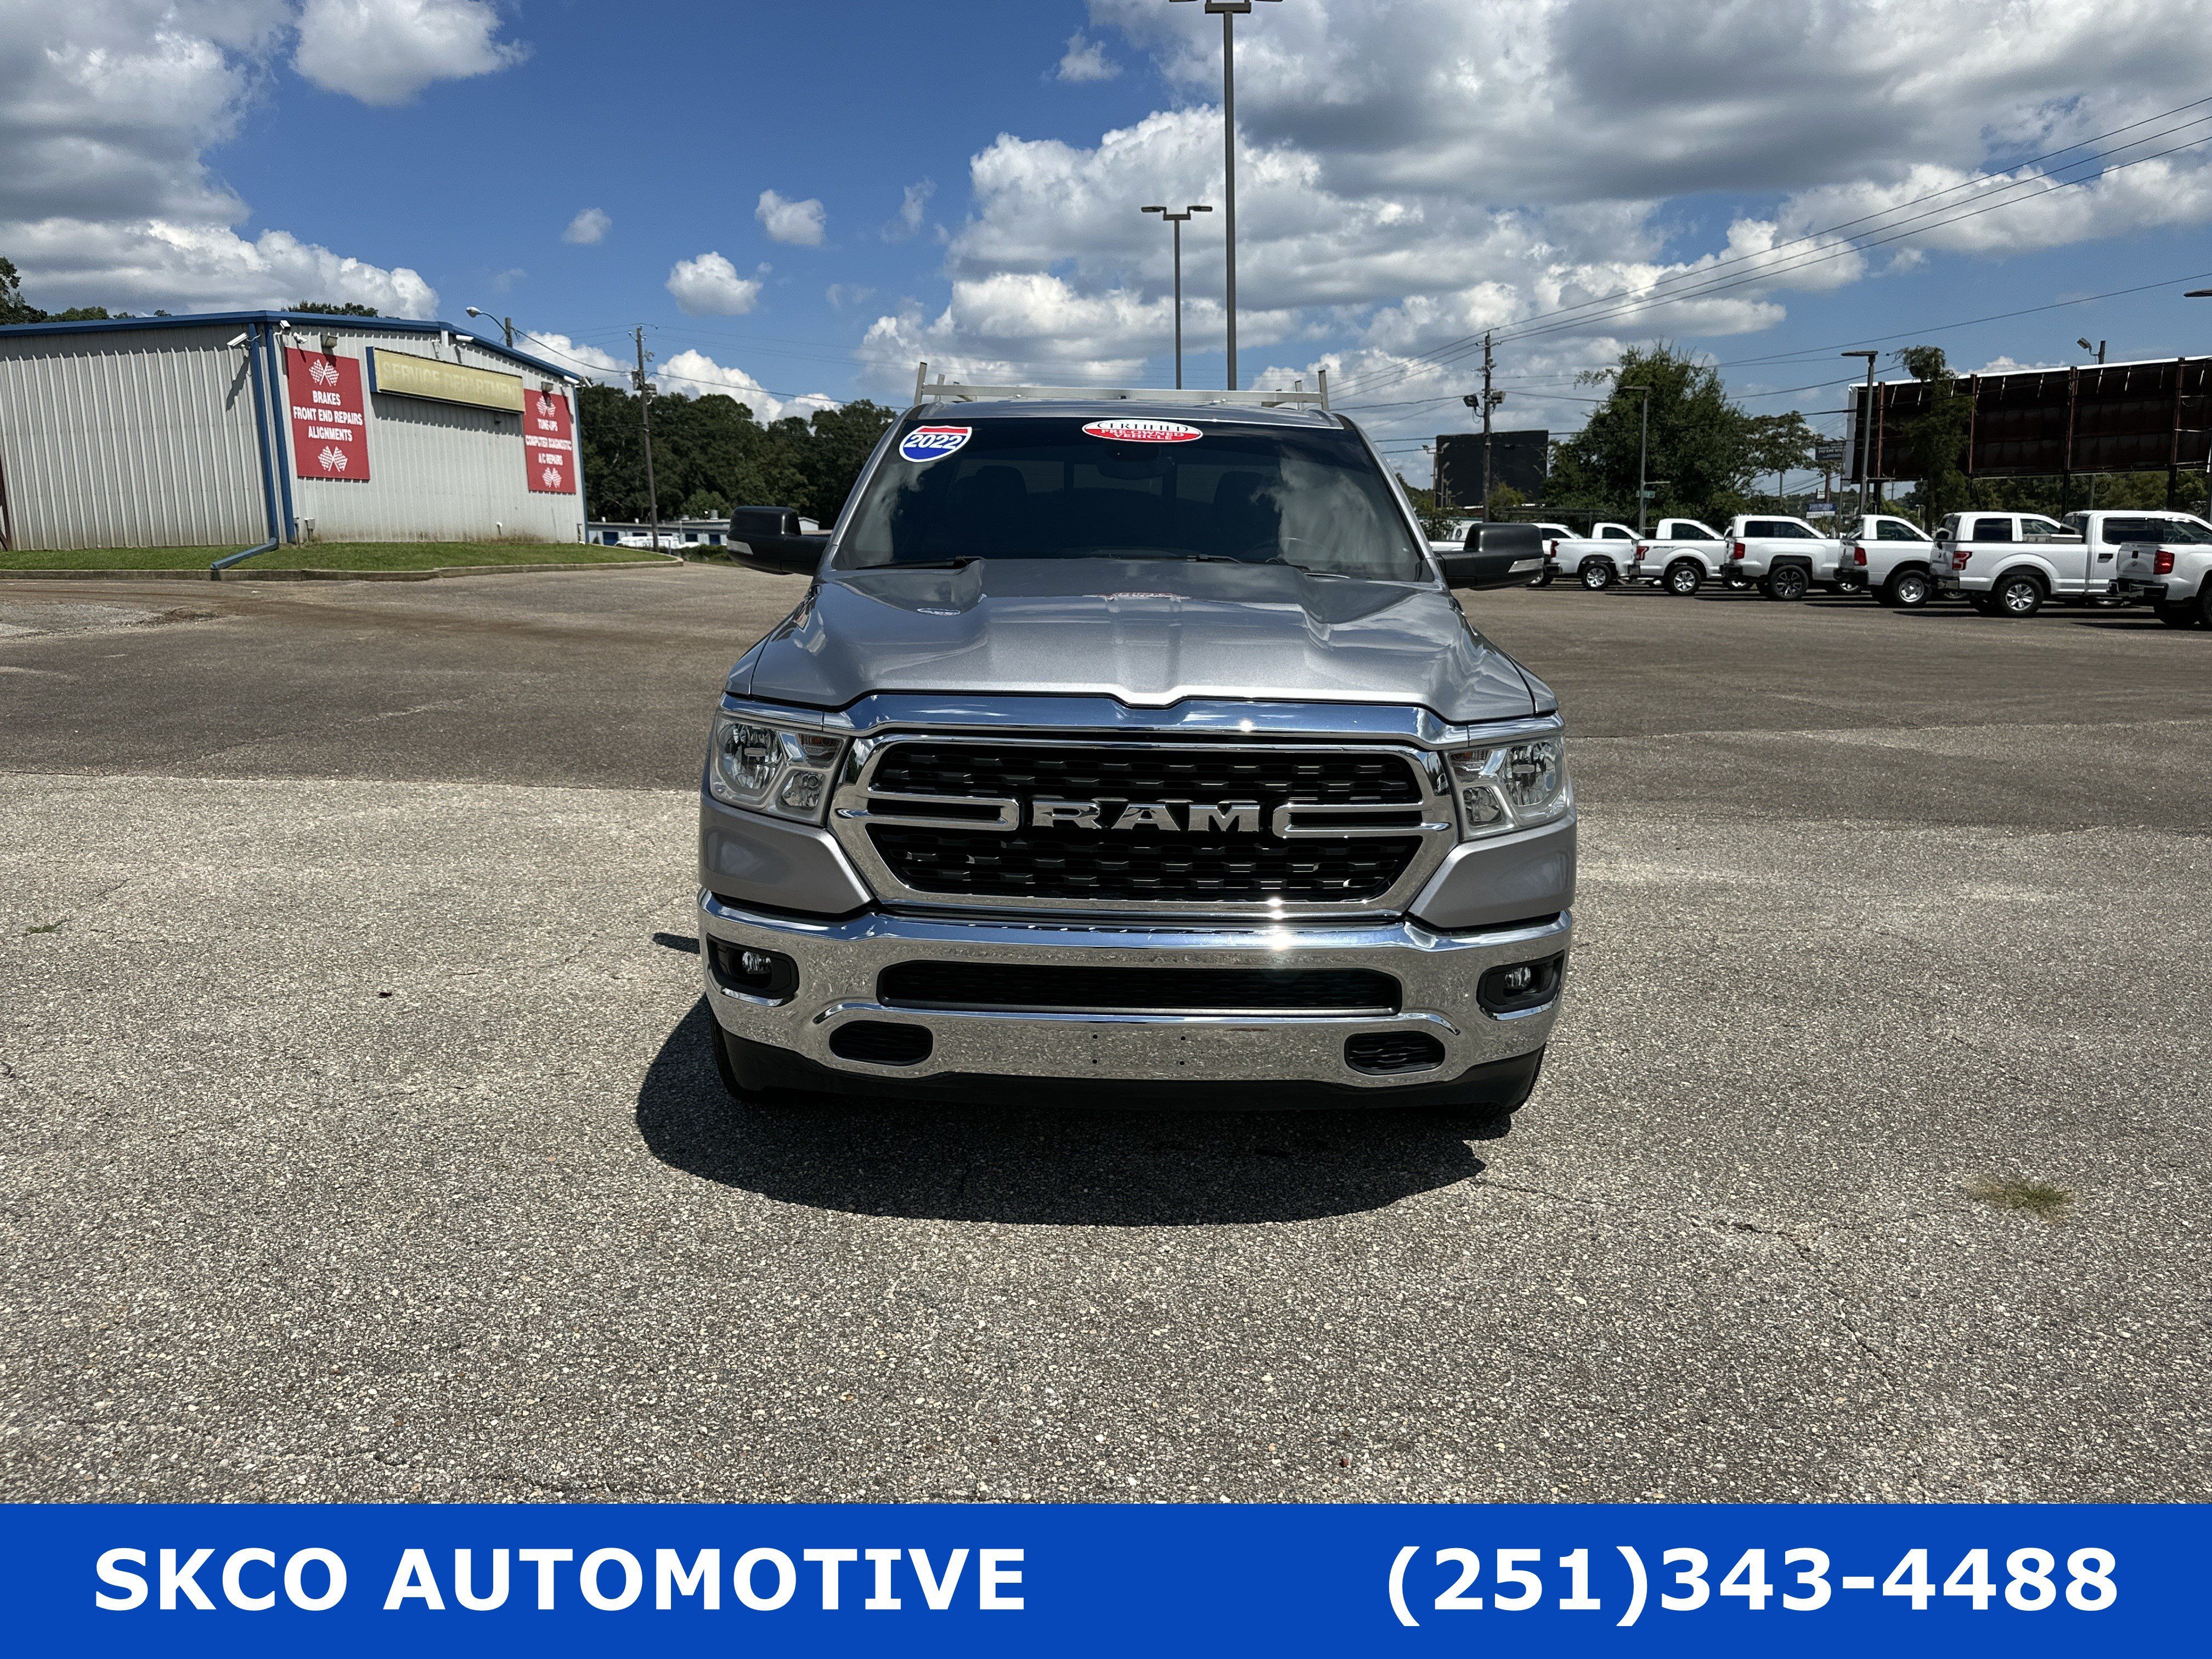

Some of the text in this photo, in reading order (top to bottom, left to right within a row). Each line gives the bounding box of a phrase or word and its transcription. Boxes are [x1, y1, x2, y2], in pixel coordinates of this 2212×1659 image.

[382, 361, 440, 382] SERVICE
[312, 390, 341, 406] BRAKES
[293, 406, 363, 426] FRONT END REPAIRS
[308, 426, 353, 442] ALIGNMENTS
[1097, 423, 1188, 432] CERTIFIED
[904, 435, 963, 449] 2022
[546, 453, 563, 466] REPAIRS
[1032, 801, 1261, 832] RAM
